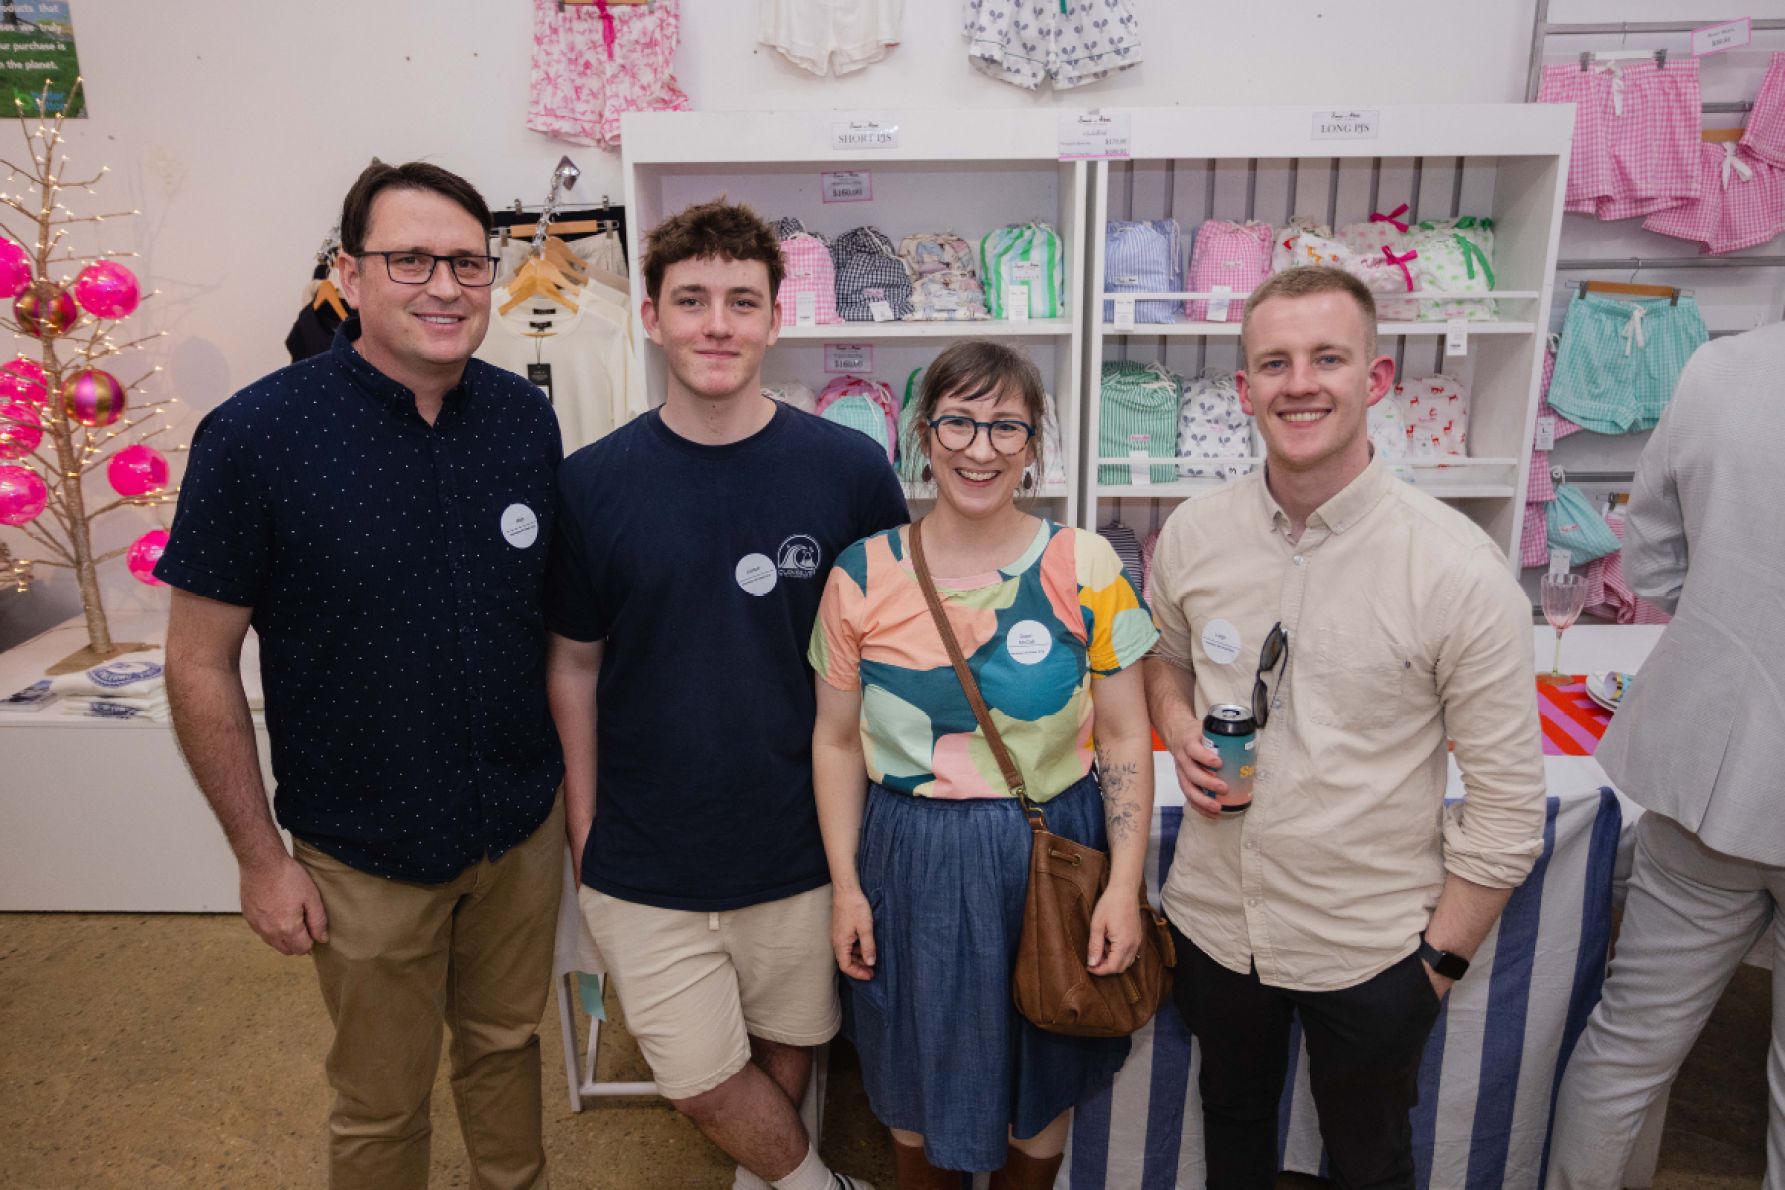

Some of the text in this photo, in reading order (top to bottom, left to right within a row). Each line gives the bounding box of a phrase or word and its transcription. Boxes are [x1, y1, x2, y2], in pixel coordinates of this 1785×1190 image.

[39, 4, 59, 12] that
[39, 22, 62, 34] truly
[13, 41, 55, 52] purchase
[6, 60, 23, 69] the
[25, 60, 58, 70] planet.
[1321, 122, 1370, 134] LONG PJS
[838, 133, 873, 144] SHORT
